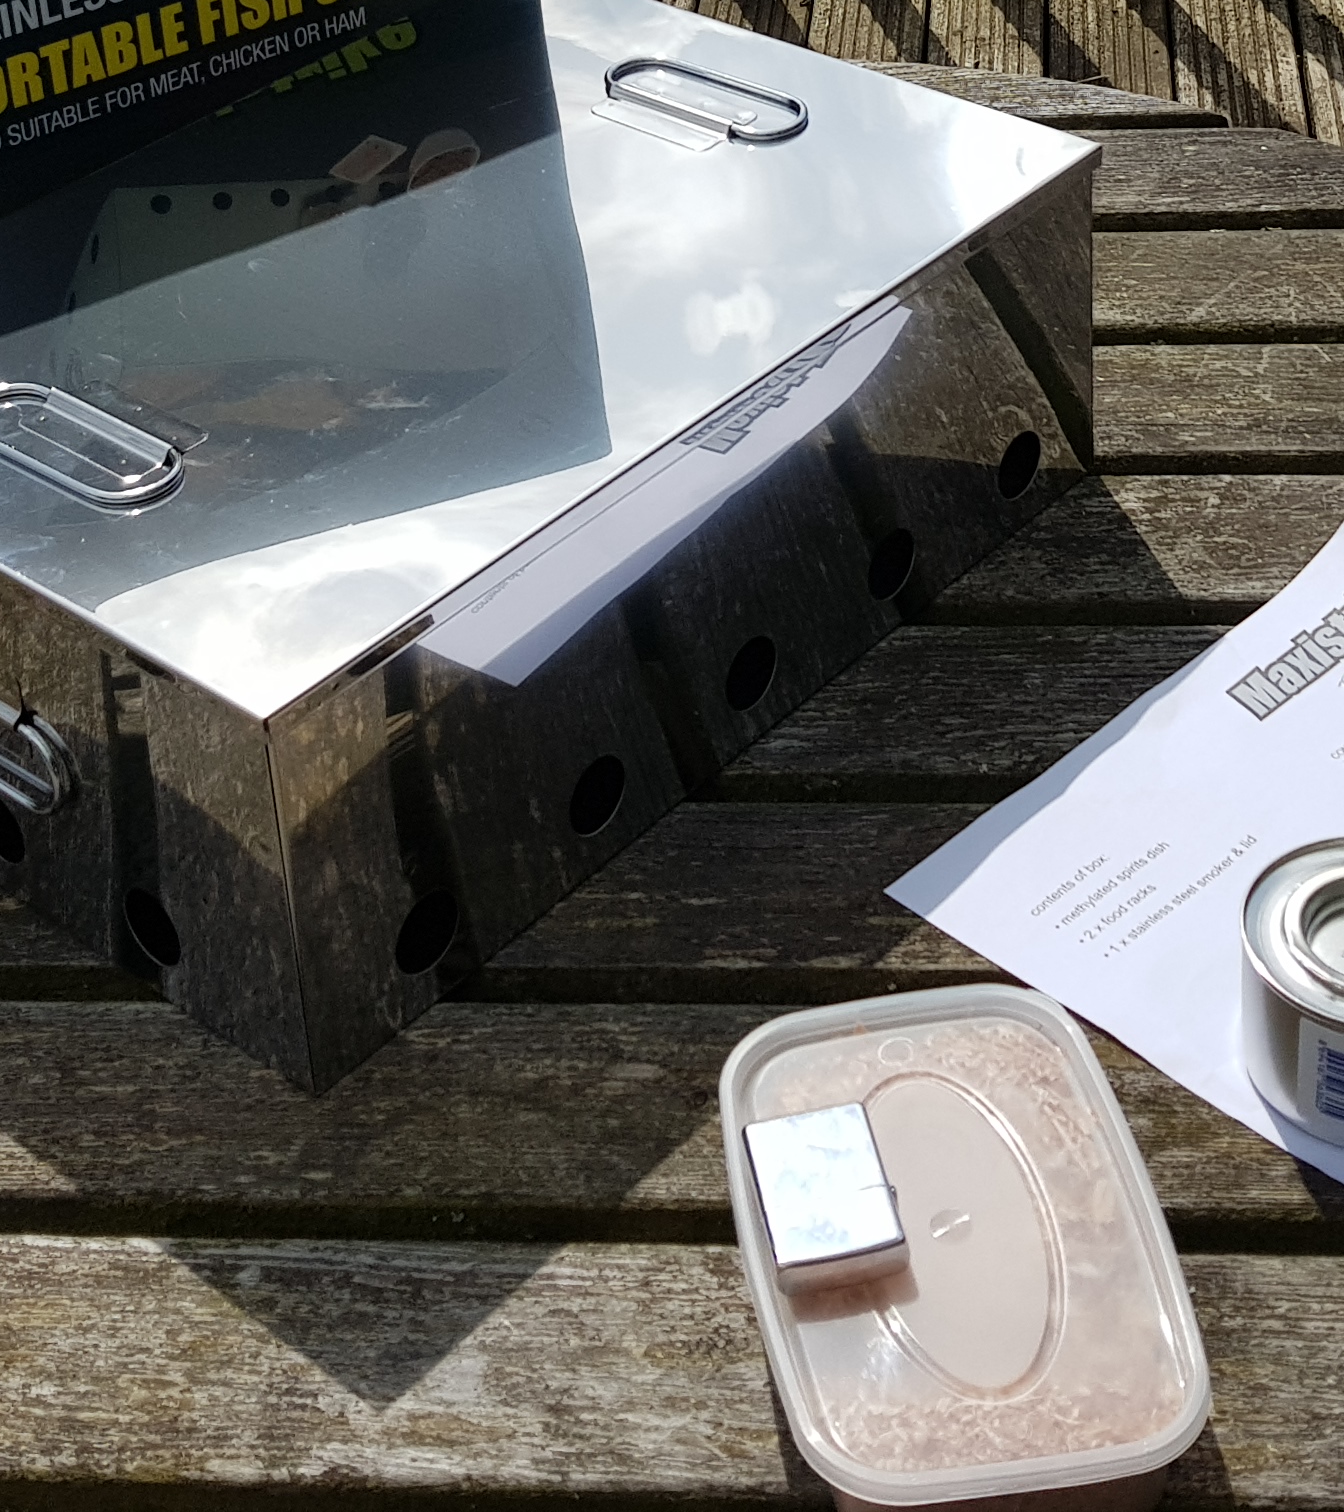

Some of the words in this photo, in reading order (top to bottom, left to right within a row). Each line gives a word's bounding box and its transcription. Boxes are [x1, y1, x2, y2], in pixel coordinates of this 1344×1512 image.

[7, 98, 102, 148] SUITABLE
[104, 82, 146, 117] FOR
[149, 60, 207, 97] MEAT,
[209, 33, 290, 78] CHICKEN
[294, 24, 322, 51] OR
[323, 6, 367, 42] HAM
[1030, 880, 1076, 917] contents
[1074, 869, 1088, 882] of
[1083, 854, 1108, 873] box:
[1061, 878, 1118, 926] methylated
[1116, 858, 1149, 882] spirits
[1146, 842, 1170, 860] dish
[1083, 929, 1097, 940] 2
[1095, 924, 1102, 933] x
[1100, 904, 1129, 926] food
[1126, 885, 1157, 908] racks
[1109, 945, 1121, 953] 1
[1120, 939, 1127, 947] x
[1127, 904, 1174, 940] stainless
[1171, 884, 1199, 905] steel
[1196, 855, 1234, 888] smoker
[1231, 848, 1244, 857] &
[1239, 834, 1258, 849] lid
